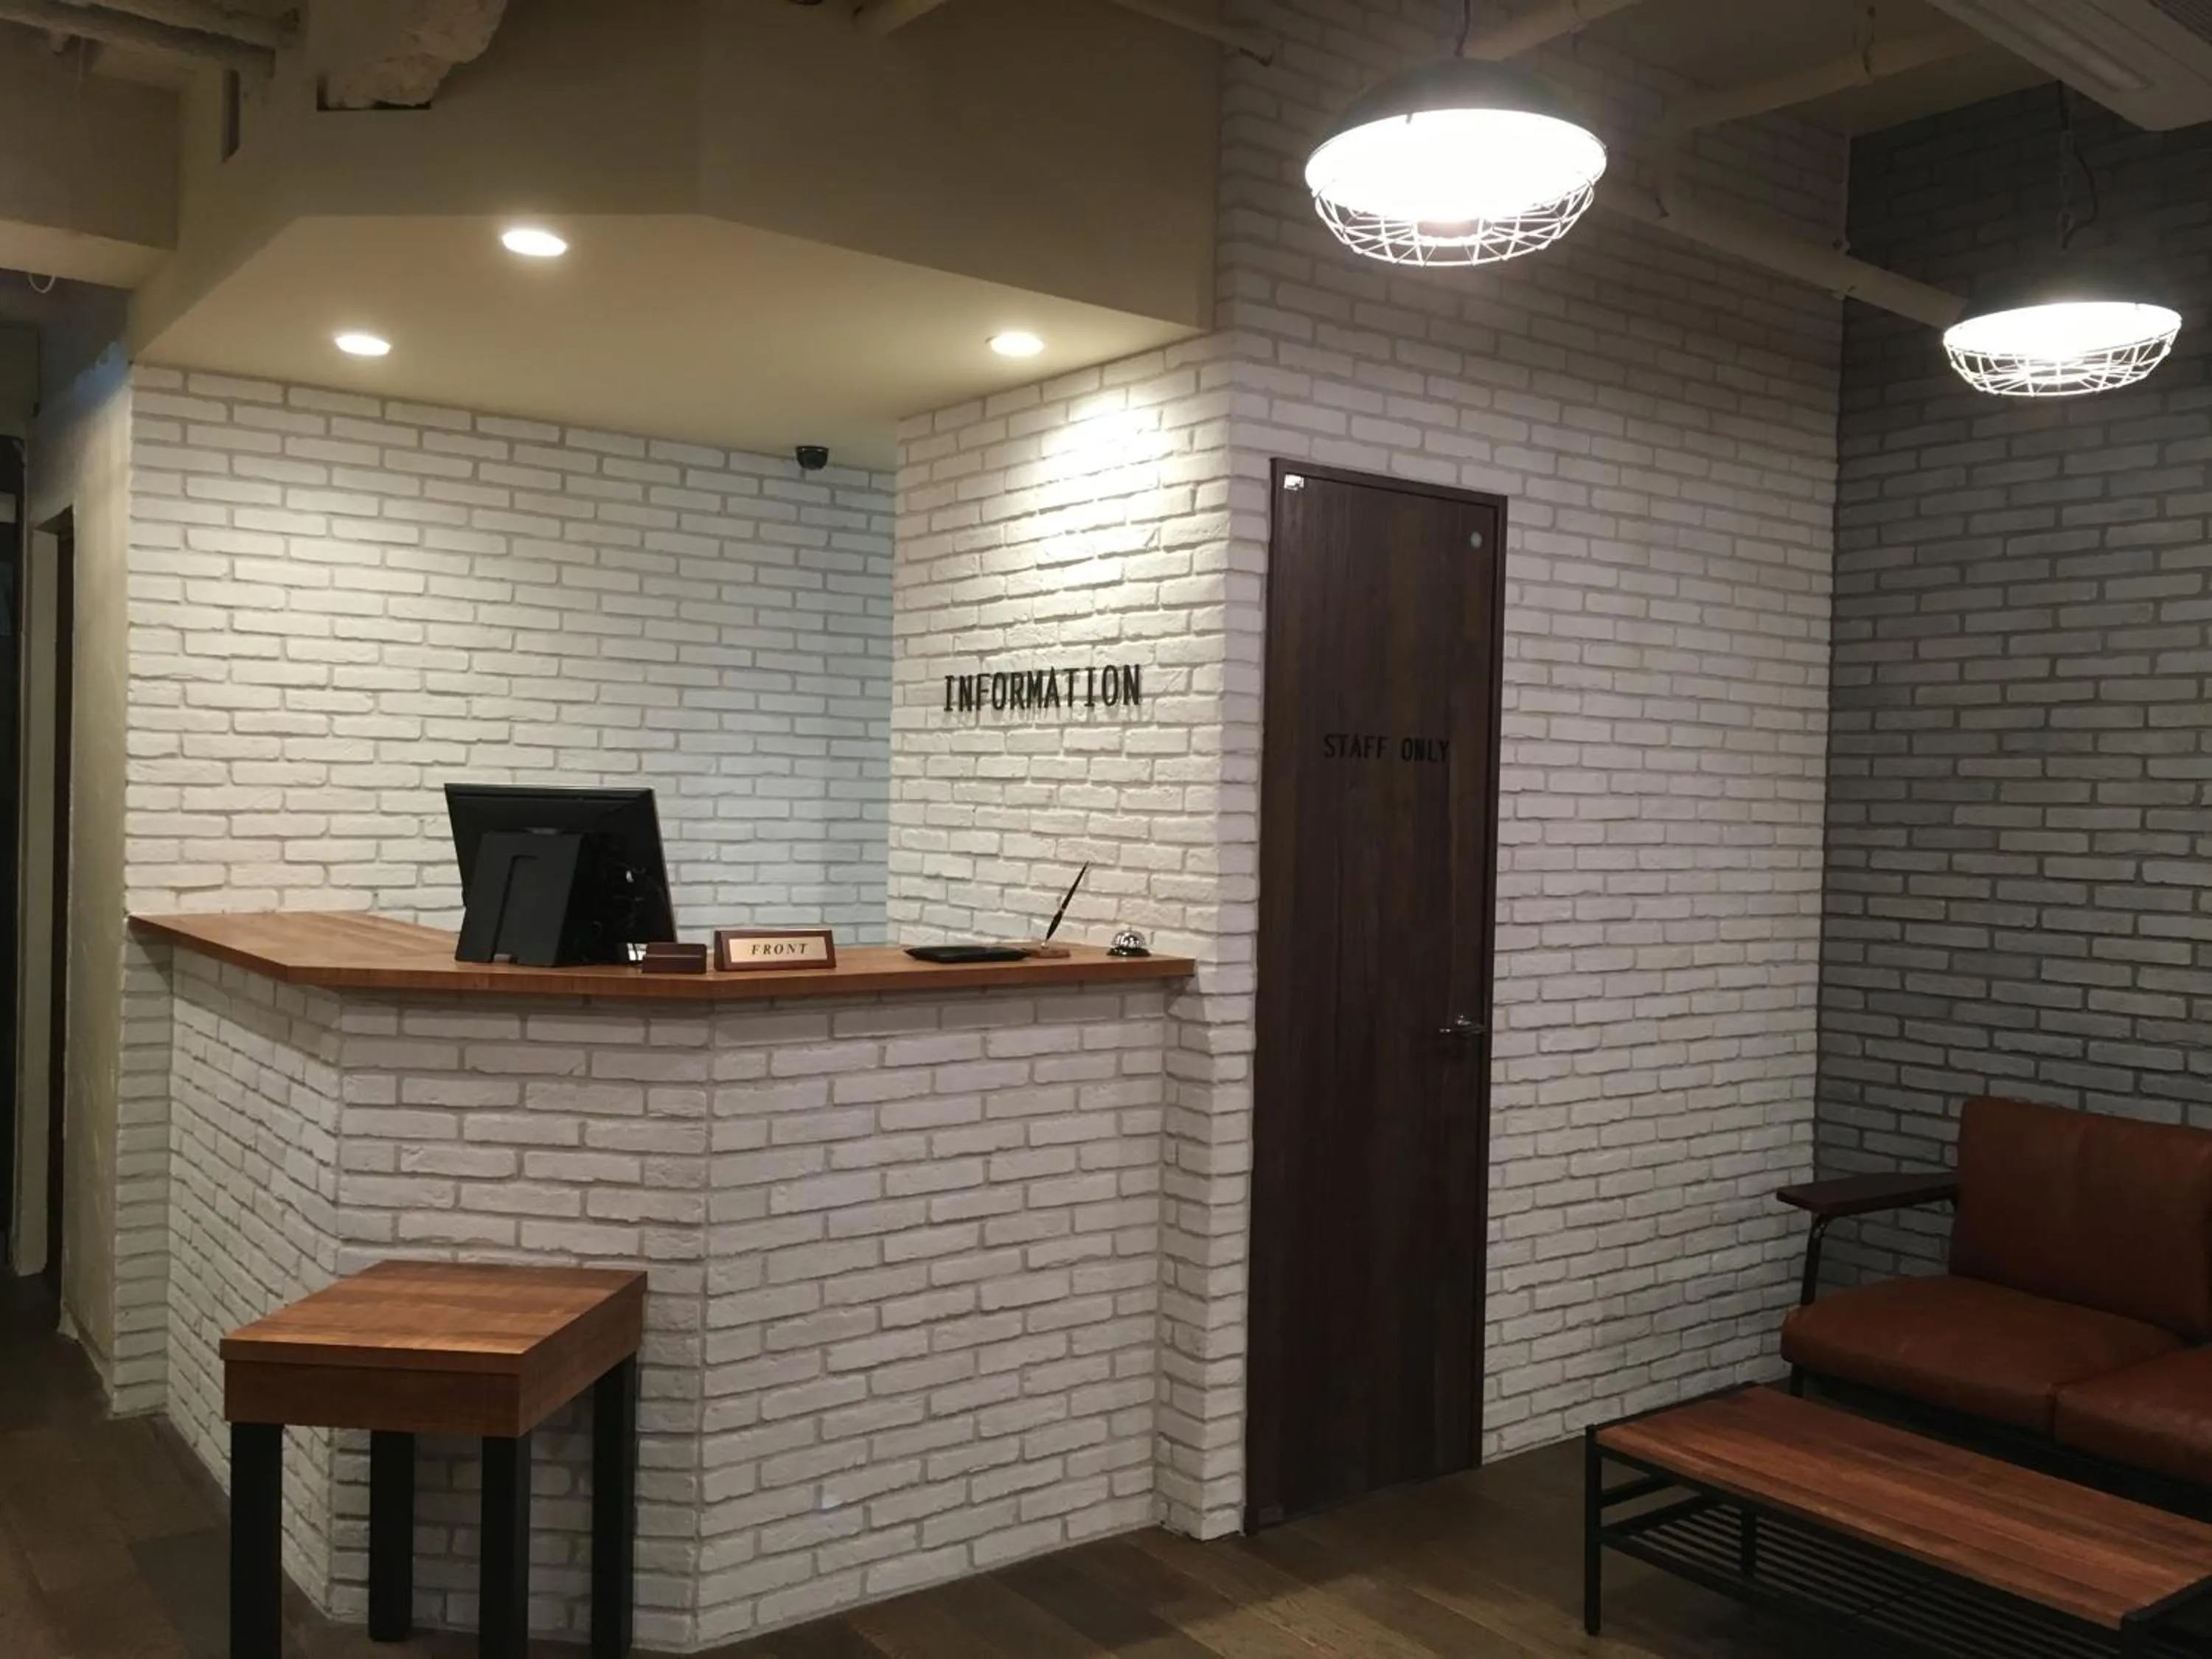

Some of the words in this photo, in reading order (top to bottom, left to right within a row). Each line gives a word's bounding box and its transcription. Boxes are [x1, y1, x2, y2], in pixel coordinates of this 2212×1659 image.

[944, 664, 1140, 712] INFORMATION
[1324, 733, 1388, 759] STAFF
[1402, 737, 1450, 762] ONLY
[751, 943, 808, 955] FRONT
